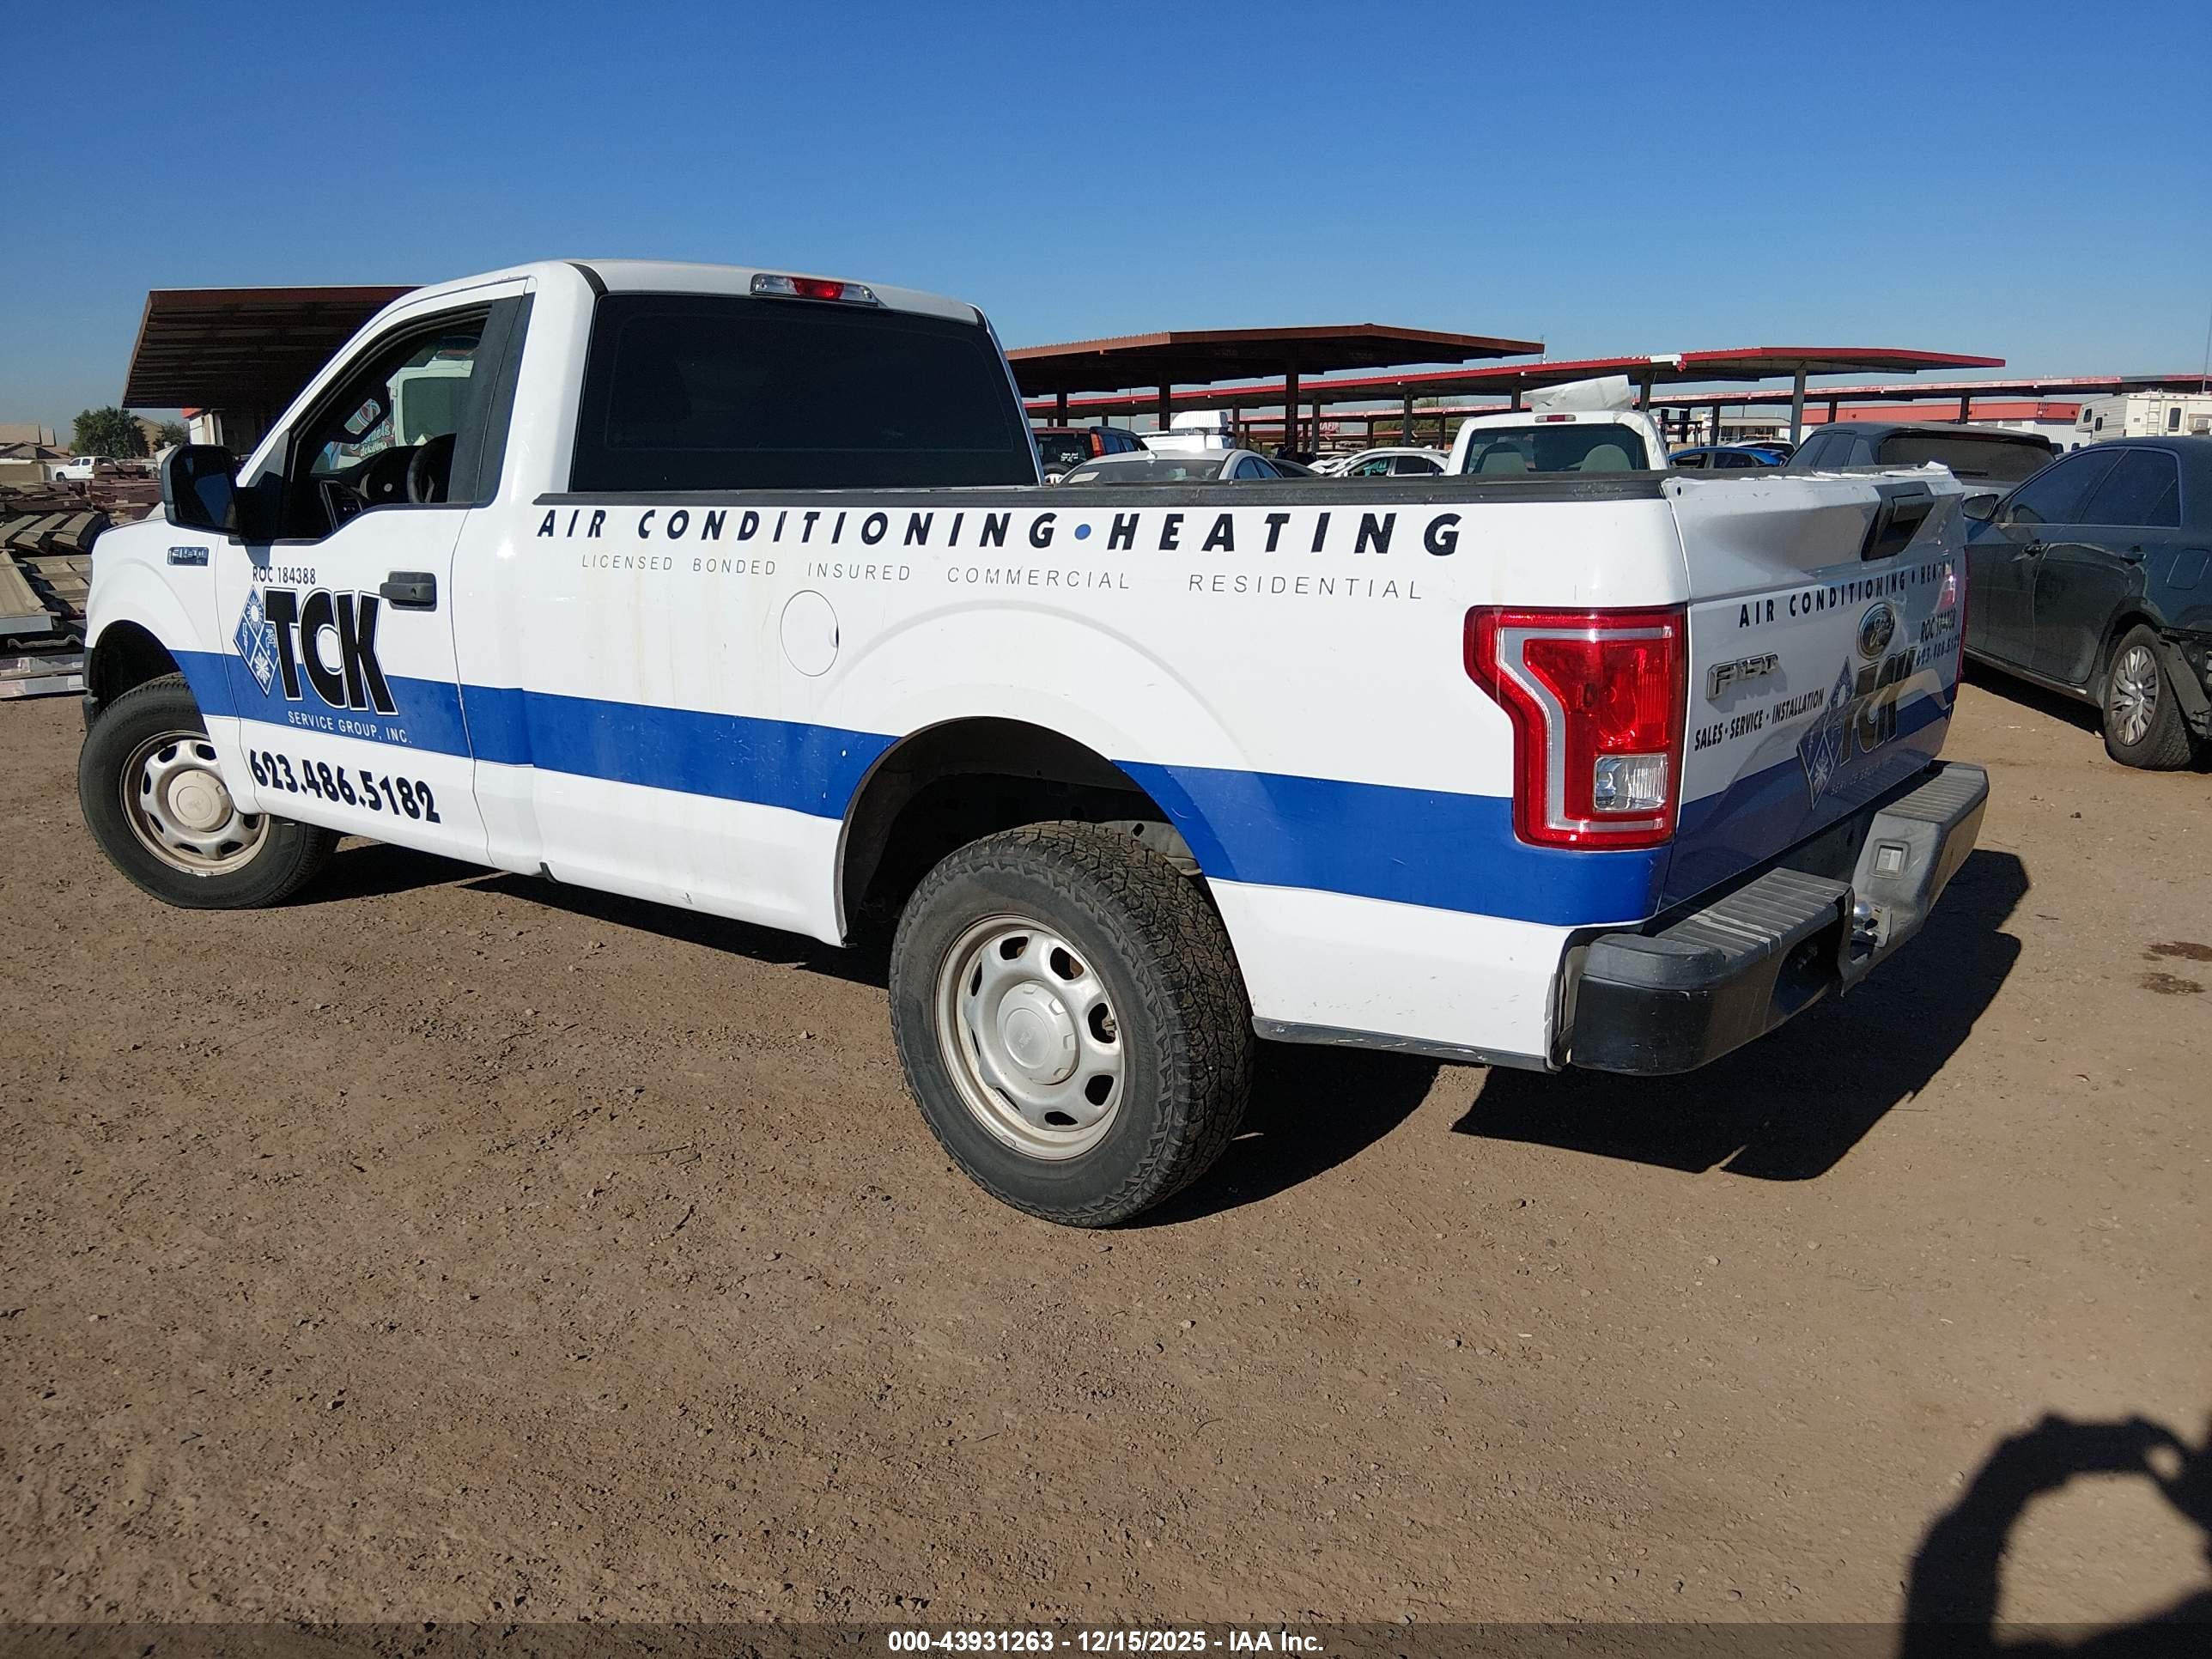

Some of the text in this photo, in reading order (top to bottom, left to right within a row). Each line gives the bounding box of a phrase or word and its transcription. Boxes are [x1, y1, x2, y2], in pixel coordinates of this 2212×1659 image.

[537, 509, 1463, 557] AIR CONDITIONING HEATING
[252, 565, 317, 585] ROC 184388
[581, 554, 1422, 600] LICENSED BONDED INSURED COMMERCIAL RESIDENTIAL
[1739, 599, 1775, 628] AIR
[1790, 569, 1905, 617] CONDITIONING
[263, 586, 399, 716] TCK
[288, 710, 412, 744] SERVICE GROUP, INC.
[1694, 687, 1825, 751] SALES SERVICE INSTALLATION
[250, 749, 441, 824] 623.486.5182
